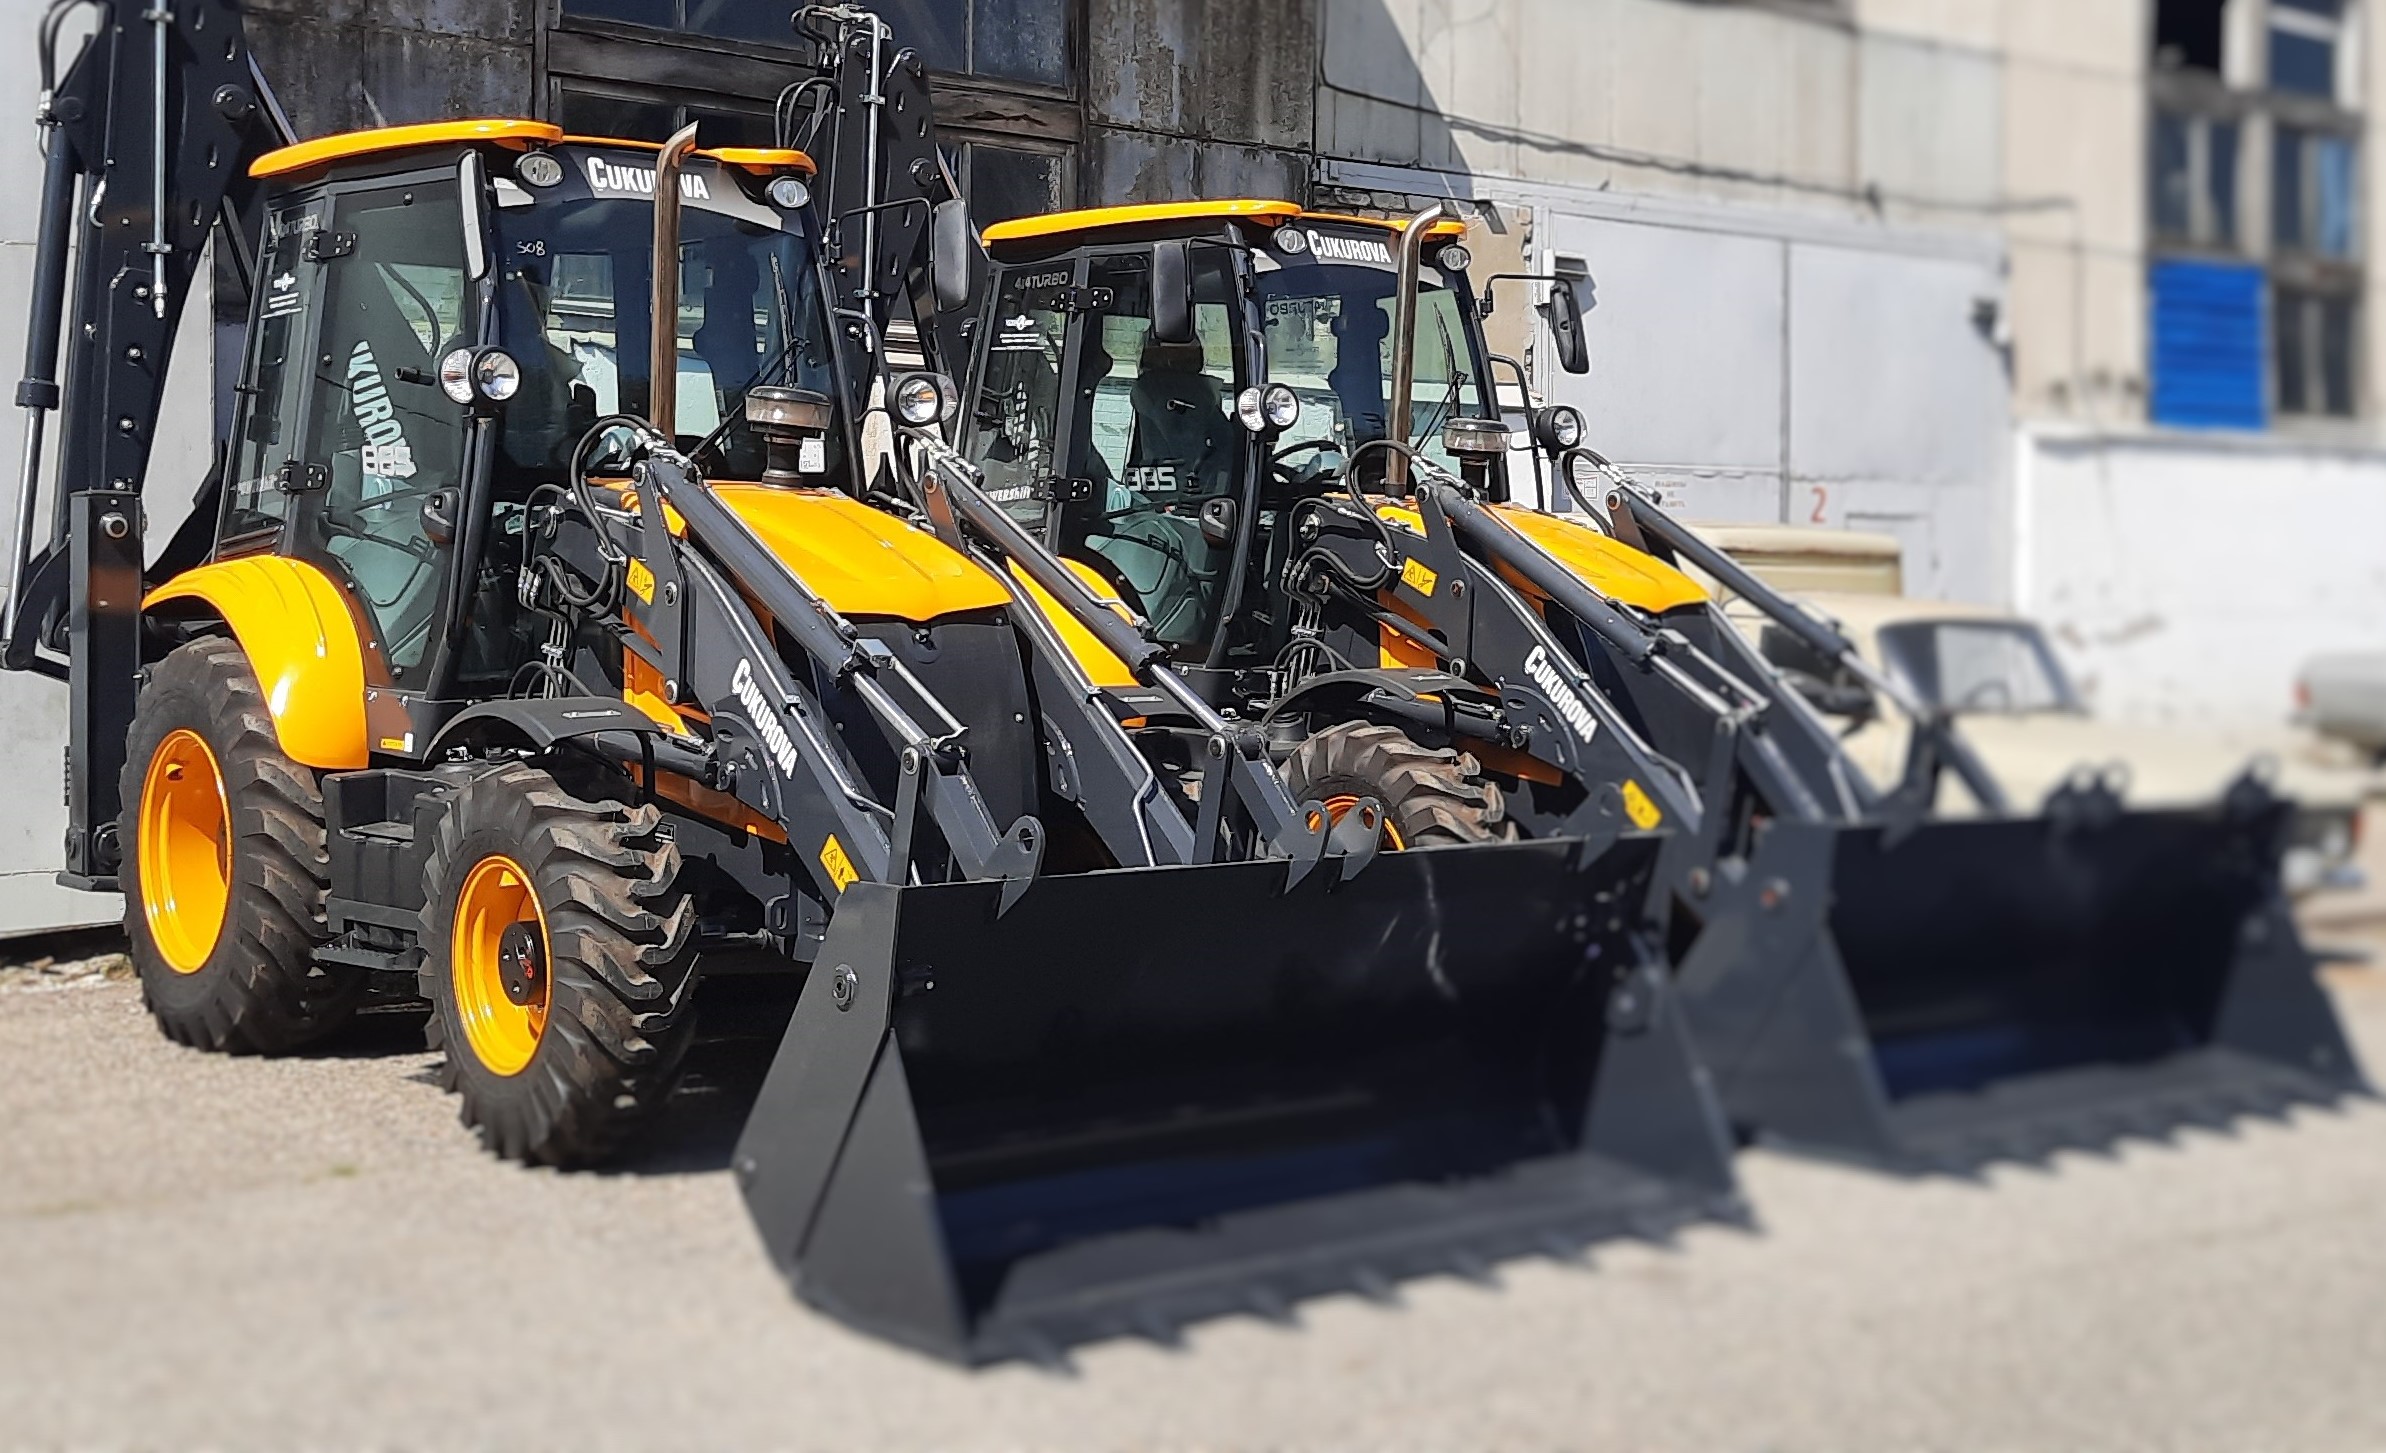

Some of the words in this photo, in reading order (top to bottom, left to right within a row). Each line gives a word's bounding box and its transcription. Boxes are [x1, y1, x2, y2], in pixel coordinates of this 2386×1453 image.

[586, 156, 710, 200] ÇUKUVA
[1306, 229, 1392, 263] ÇUKUROVA
[1810, 486, 1827, 523] 2
[1525, 645, 1598, 743] ÇUKUROVA
[732, 658, 797, 779] ÇUKUROVA
